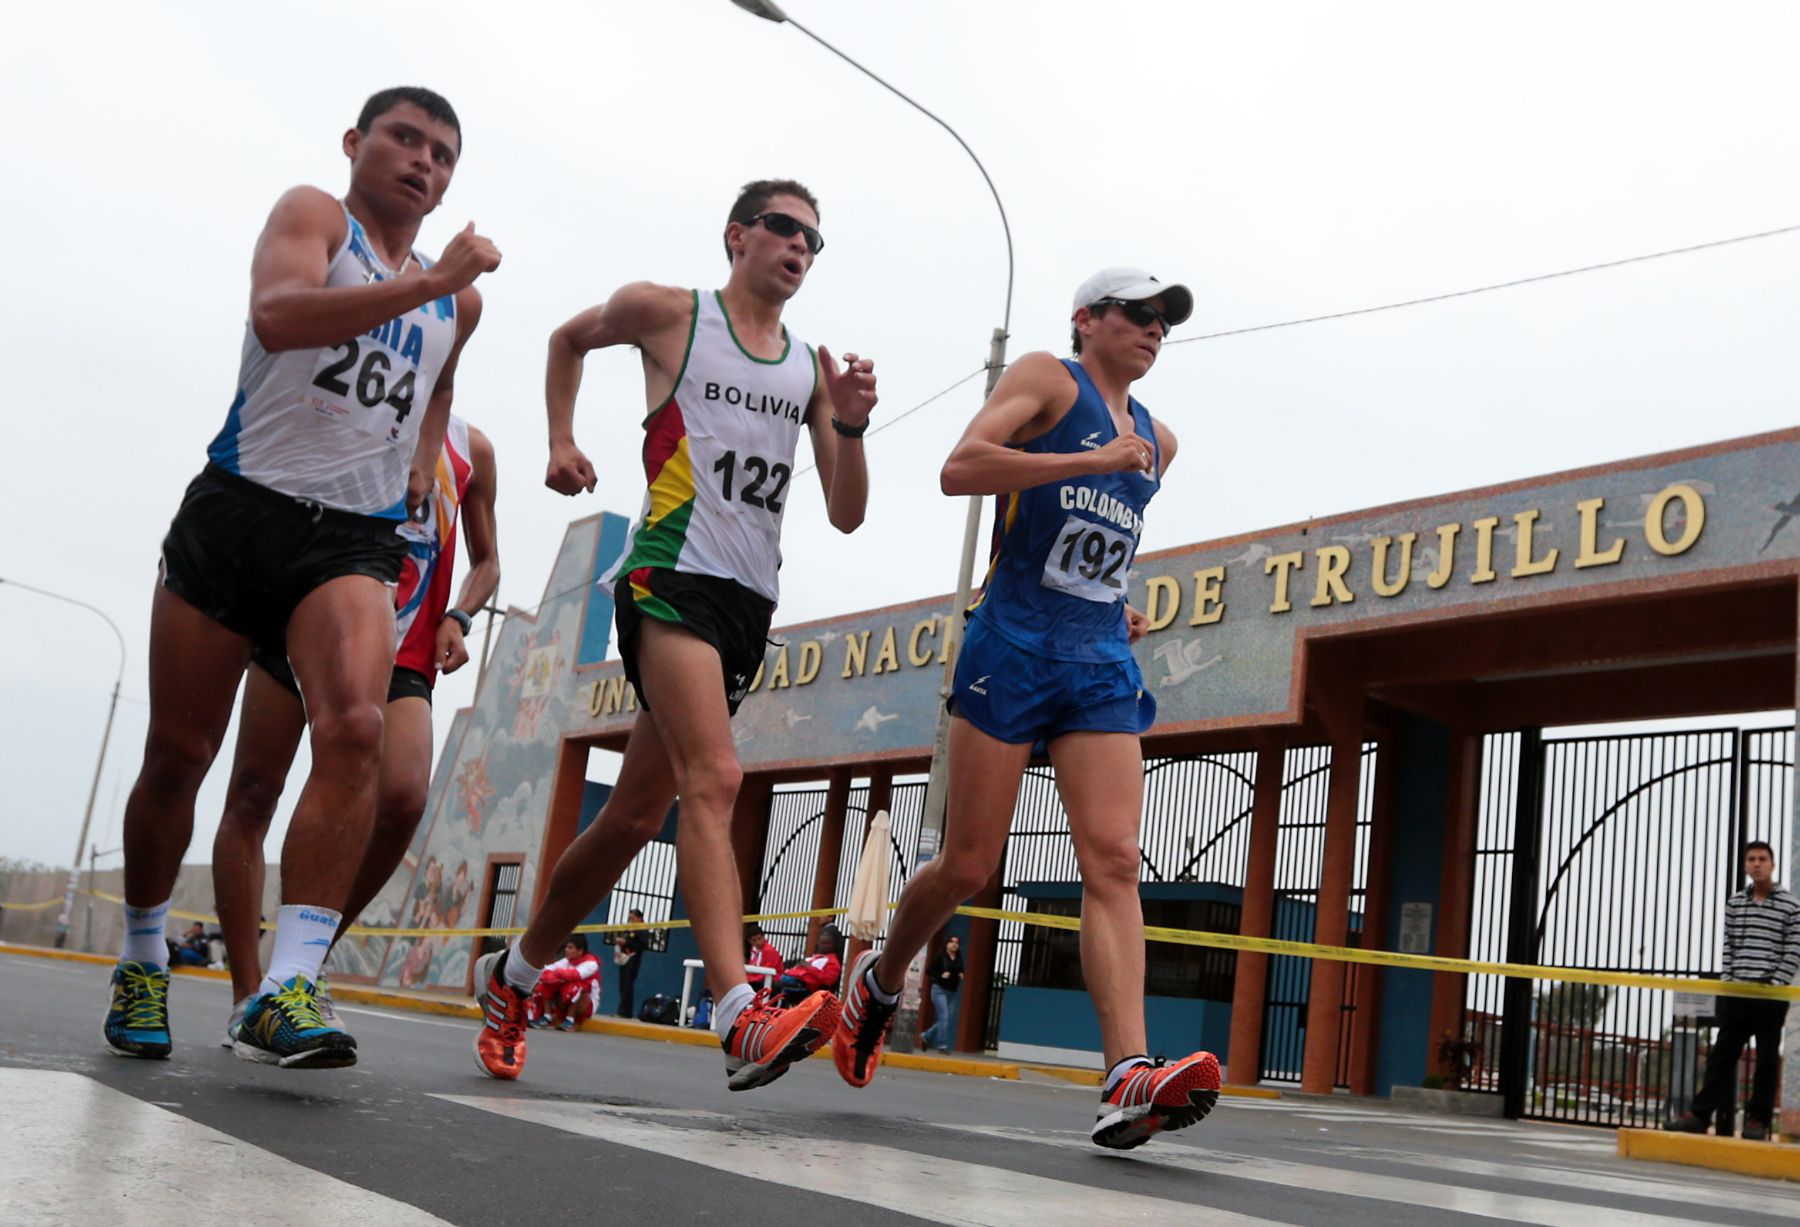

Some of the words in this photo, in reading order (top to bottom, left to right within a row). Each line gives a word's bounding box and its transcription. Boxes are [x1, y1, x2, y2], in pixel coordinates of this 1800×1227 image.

[312, 340, 417, 424] 264
[704, 382, 800, 425] BOLIVIA
[713, 450, 790, 514] 122
[1059, 528, 1127, 589] 192
[1144, 566, 1226, 632] DE
[1265, 484, 1706, 614] TRUJILLO
